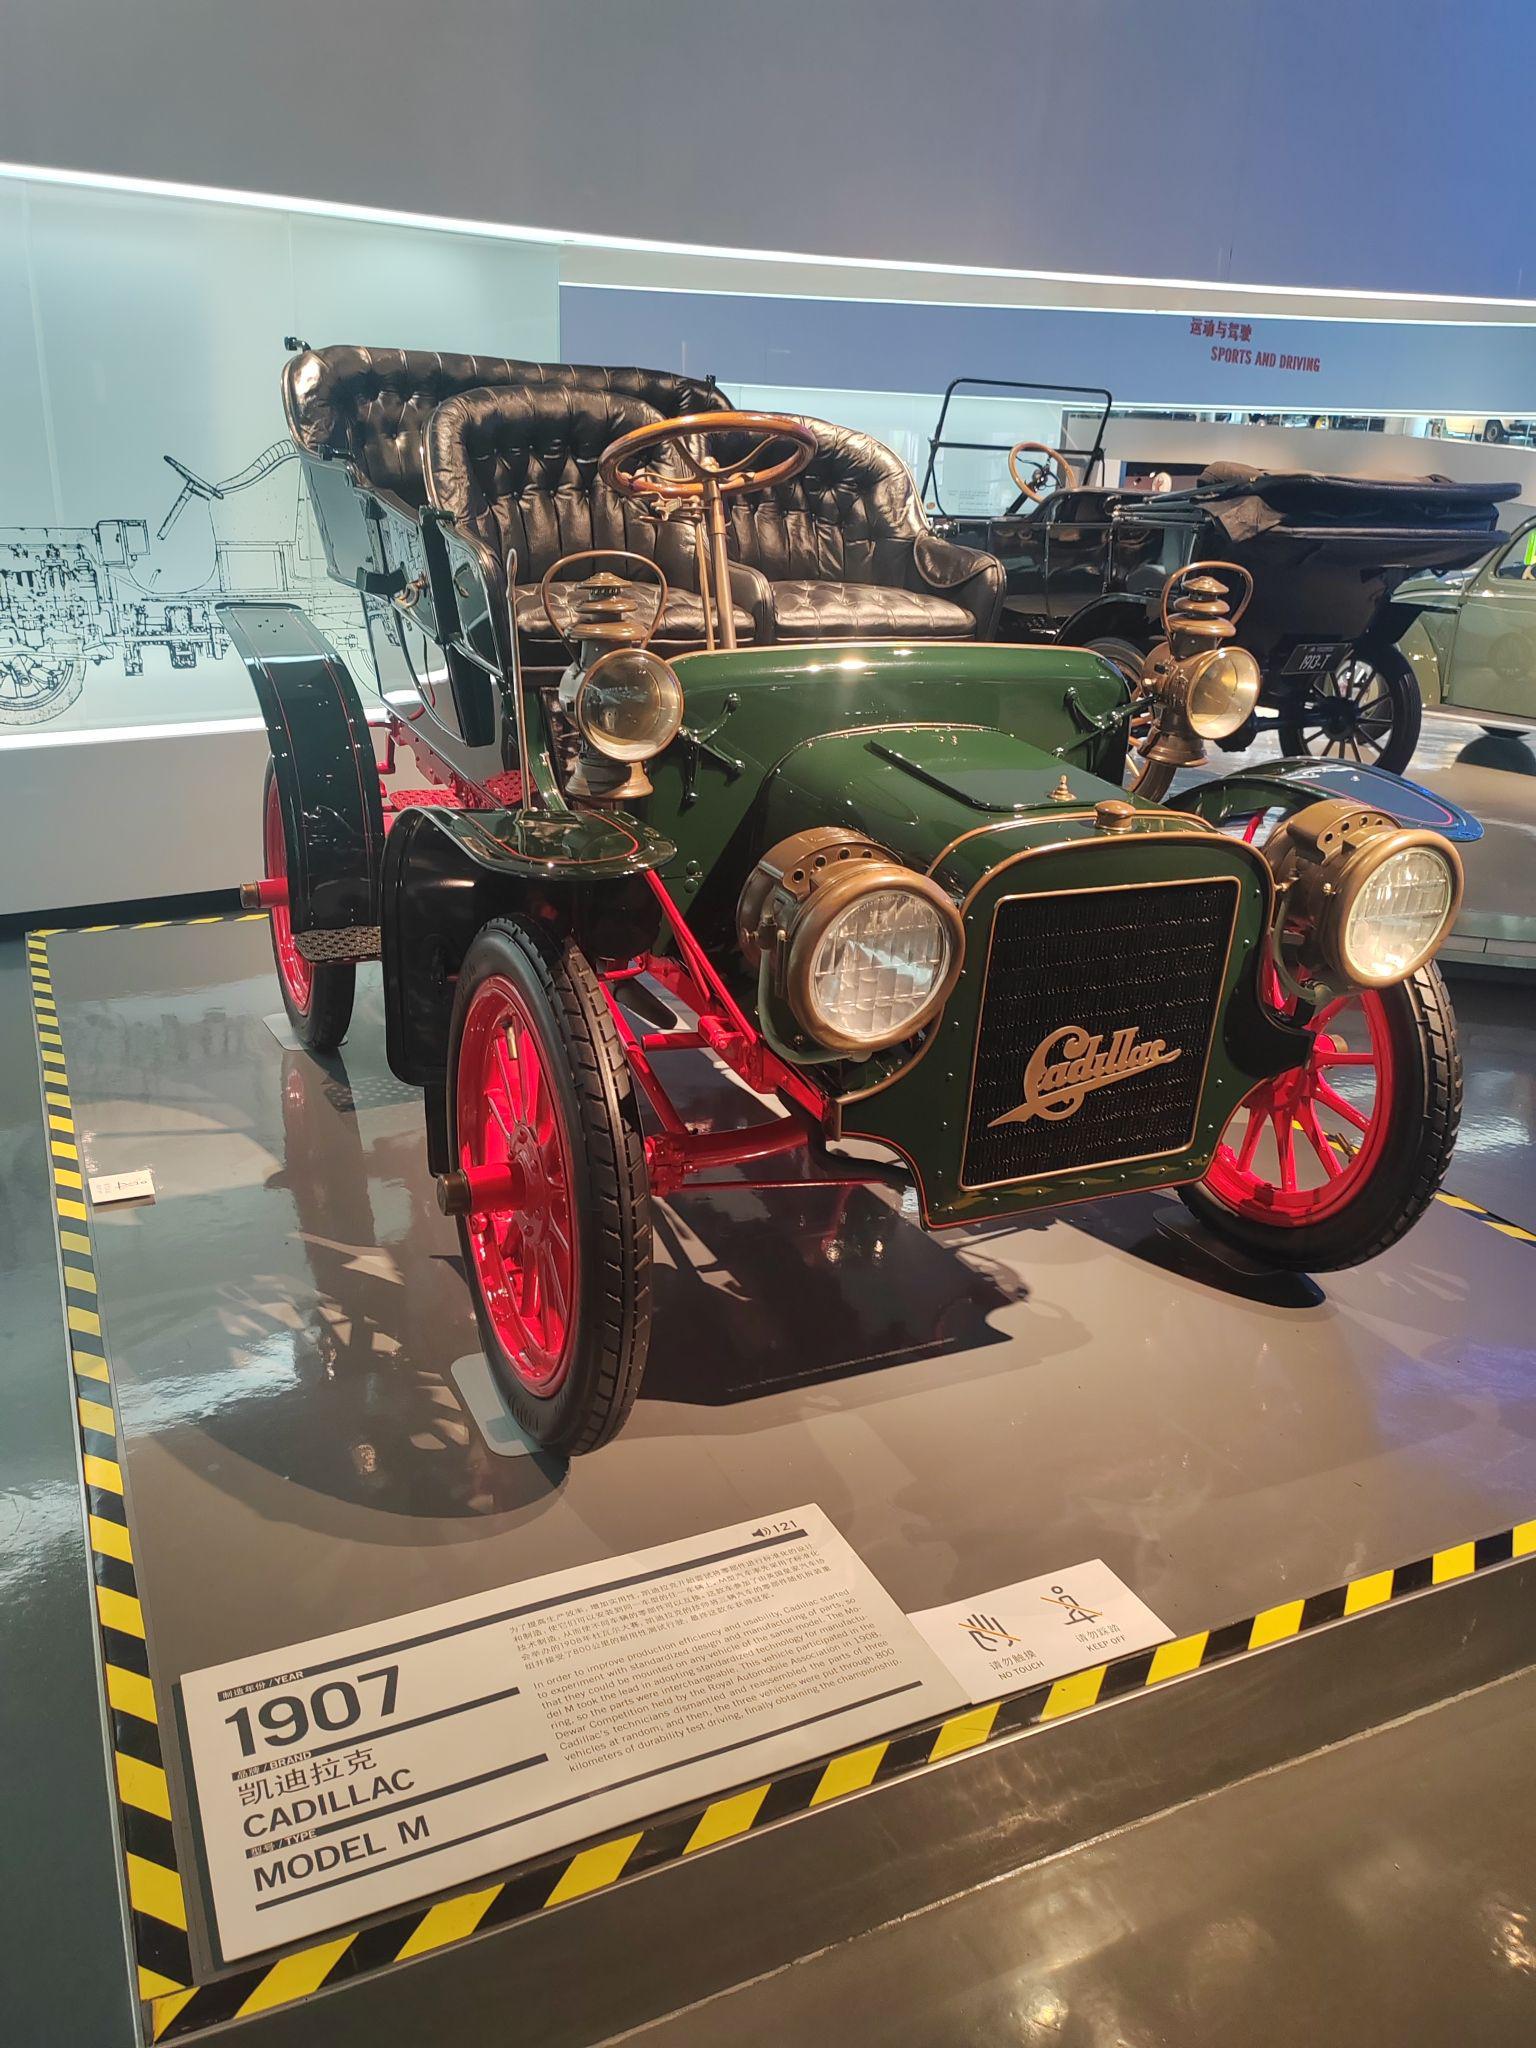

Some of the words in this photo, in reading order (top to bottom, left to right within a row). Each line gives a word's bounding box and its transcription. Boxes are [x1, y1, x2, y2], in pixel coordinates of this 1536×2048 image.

[1190, 318, 1252, 342] 运动与驾驶
[1211, 346, 1252, 365] SPORTS
[1255, 352, 1276, 367] AND
[1280, 354, 1320, 372] DRIVING
[1299, 655, 1331, 669] 1913-T
[987, 1026, 1181, 1127] Cadillac
[772, 1520, 798, 1534] 121
[542, 1697, 562, 1708] that
[564, 1691, 586, 1702] they
[588, 1681, 615, 1694] could
[632, 1663, 674, 1681] mounted
[676, 1660, 688, 1668] on
[689, 1654, 707, 1663] any
[707, 1644, 741, 1658] vehicle
[753, 1636, 769, 1644] the
[770, 1628, 795, 1638] same
[827, 1612, 845, 1621] The
[546, 1673, 573, 1685] order
[586, 1657, 626, 1673] improve
[627, 1642, 678, 1662] production
[677, 1628, 723, 1645] efficiency
[723, 1622, 741, 1632] and
[742, 1612, 784, 1626] usability,
[783, 1600, 819, 1613] Cadillac
[820, 1589, 851, 1602] started
[546, 1708, 562, 1718] del
[564, 1704, 575, 1713] M
[577, 1697, 598, 1709] took
[600, 1693, 617, 1702] the
[619, 1685, 640, 1696] lead
[653, 1669, 696, 1685] adopting
[696, 1649, 755, 1672] standardized
[755, 1635, 806, 1654] technology
[819, 1616, 870, 1634] manufactu-
[550, 1673, 606, 1695] experiment
[606, 1666, 628, 1677] with
[630, 1648, 690, 1670] standardized
[691, 1639, 723, 1652] design
[723, 1632, 741, 1642] and
[742, 1613, 808, 1636] manufacturing
[819, 1603, 846, 1614] parts,
[989, 1649, 1037, 1670] 请勿触摸
[998, 1672, 1013, 1680] NO
[1013, 1661, 1044, 1675] TOUCH
[1086, 1640, 1108, 1652] KEEP
[1110, 1635, 1125, 1645] OFF
[225, 1665, 399, 1757] 1907
[275, 1671, 304, 1685] YEAR
[550, 1719, 575, 1729] ring,
[577, 1713, 588, 1721] so
[590, 1707, 608, 1716] the
[609, 1699, 636, 1712] parts
[636, 1691, 660, 1702] were
[740, 1660, 761, 1669] This
[761, 1649, 794, 1663] vehicle
[795, 1631, 850, 1654] participated
[860, 1624, 876, 1632] the
[555, 1725, 587, 1739] Dewar
[589, 1706, 651, 1728] Competition
[652, 1697, 674, 1709] held
[690, 1688, 706, 1697] the
[708, 1678, 736, 1691] Royal
[736, 1662, 789, 1682] Automobile
[790, 1645, 842, 1665] Association
[559, 1730, 610, 1750] Cadillac's
[613, 1711, 671, 1733] technicians
[672, 1692, 726, 1714] dismantled
[728, 1685, 747, 1696] and
[749, 1666, 808, 1689] reassembled
[809, 1661, 826, 1670] the
[827, 1653, 853, 1666] parts
[853, 1648, 864, 1656] of
[865, 1641, 890, 1652] three
[564, 1743, 607, 1761] vehicles
[608, 1738, 620, 1747] at
[622, 1725, 664, 1742] random;
[665, 1717, 685, 1728] and
[686, 1711, 713, 1721] then,
[713, 1703, 730, 1712] the
[732, 1694, 758, 1706] three
[758, 1682, 798, 1698] vehicles
[799, 1674, 821, 1685] were
[822, 1668, 840, 1679] put
[839, 1656, 876, 1672] through
[876, 1649, 897, 1660] 800
[569, 1750, 624, 1772] kilometers
[624, 1744, 636, 1754] of
[637, 1730, 686, 1750] durability
[686, 1722, 706, 1734] test
[706, 1712, 745, 1727] driving,
[744, 1701, 775, 1714] finally
[774, 1686, 820, 1704] obtaining
[819, 1681, 836, 1690] the
[836, 1661, 904, 1684] championship.
[238, 1748, 377, 1806] 凯迪拉克
[269, 1752, 312, 1769] BRAND
[243, 1769, 414, 1837] CADILLAC
[285, 1828, 317, 1845] TYPE
[254, 1833, 387, 1892] MODEL
[398, 1815, 429, 1844] M
